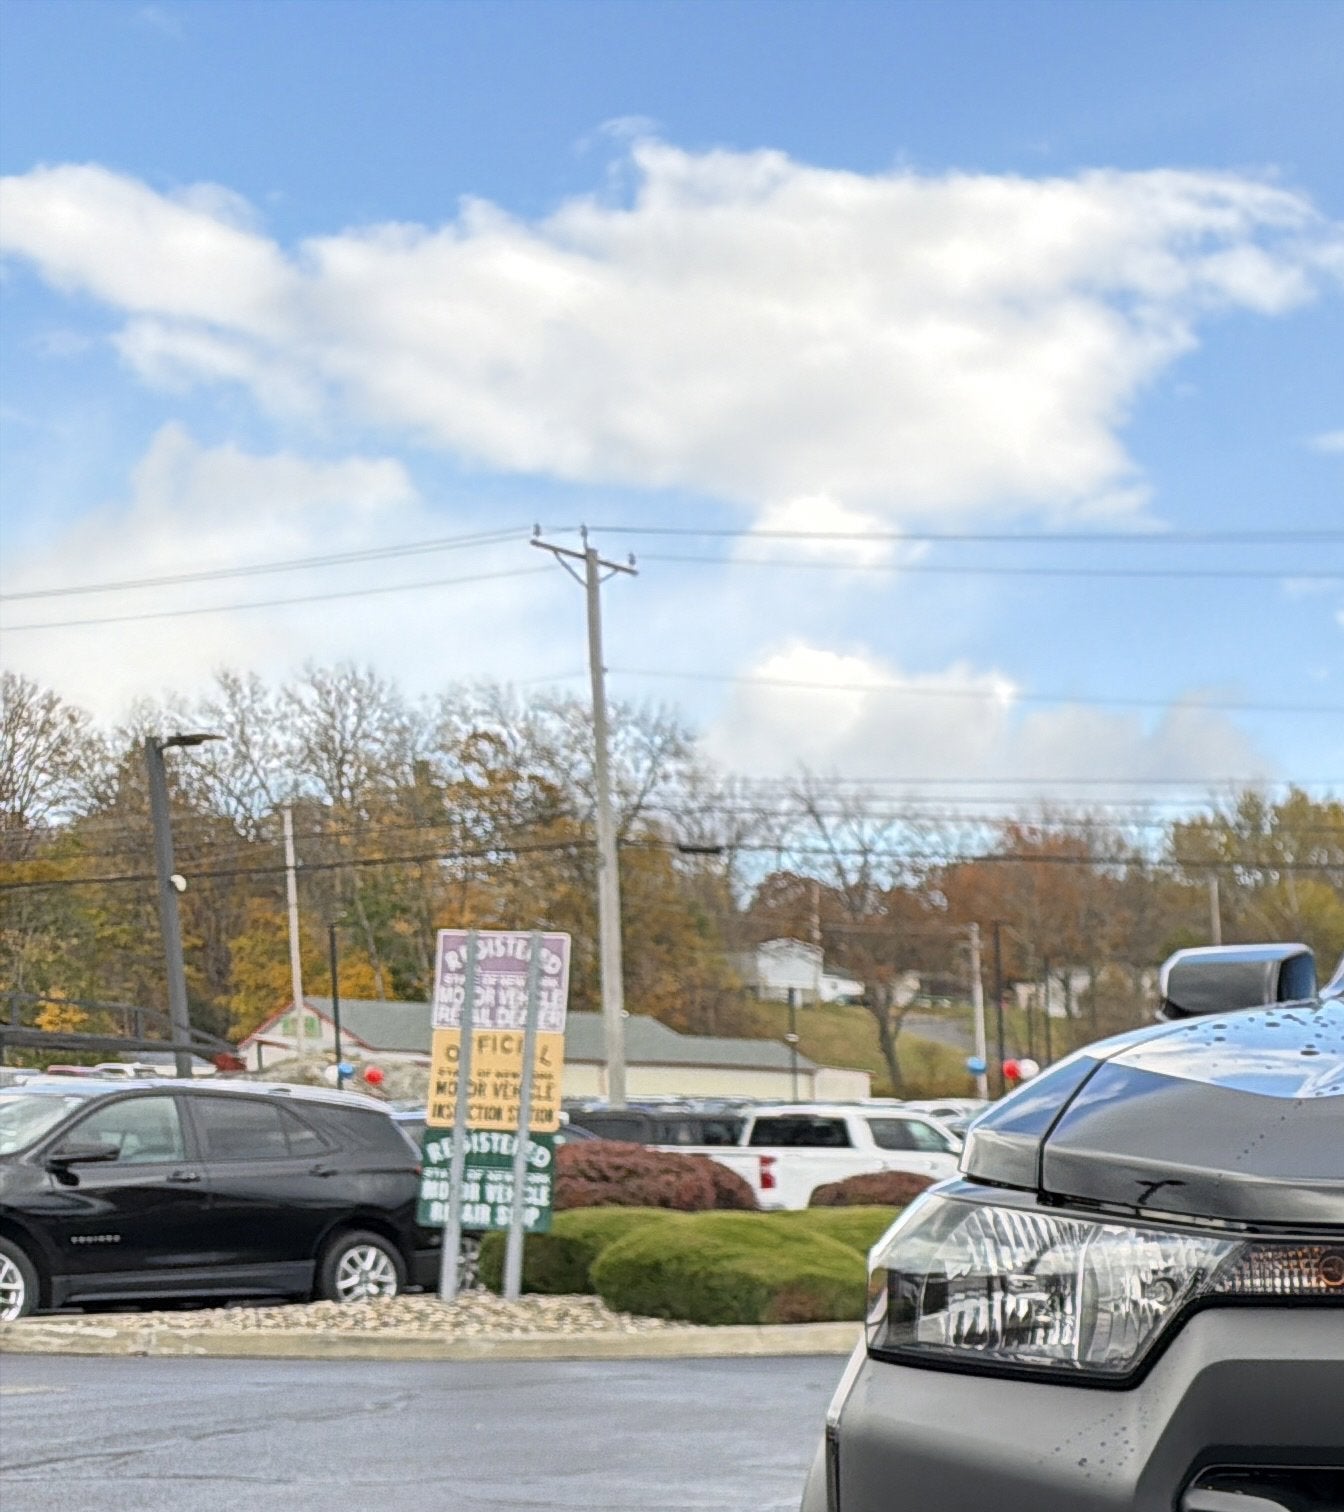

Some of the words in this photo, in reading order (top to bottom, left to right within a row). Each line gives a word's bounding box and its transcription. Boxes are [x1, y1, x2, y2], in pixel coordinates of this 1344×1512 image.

[440, 985, 496, 1007] MOOR
[445, 1033, 553, 1067] OFICIL
[436, 1081, 487, 1098] MOOR
[432, 1103, 503, 1121] INSCTION
[421, 1181, 480, 1202] MOOR
[430, 1201, 491, 1225] REAIR
